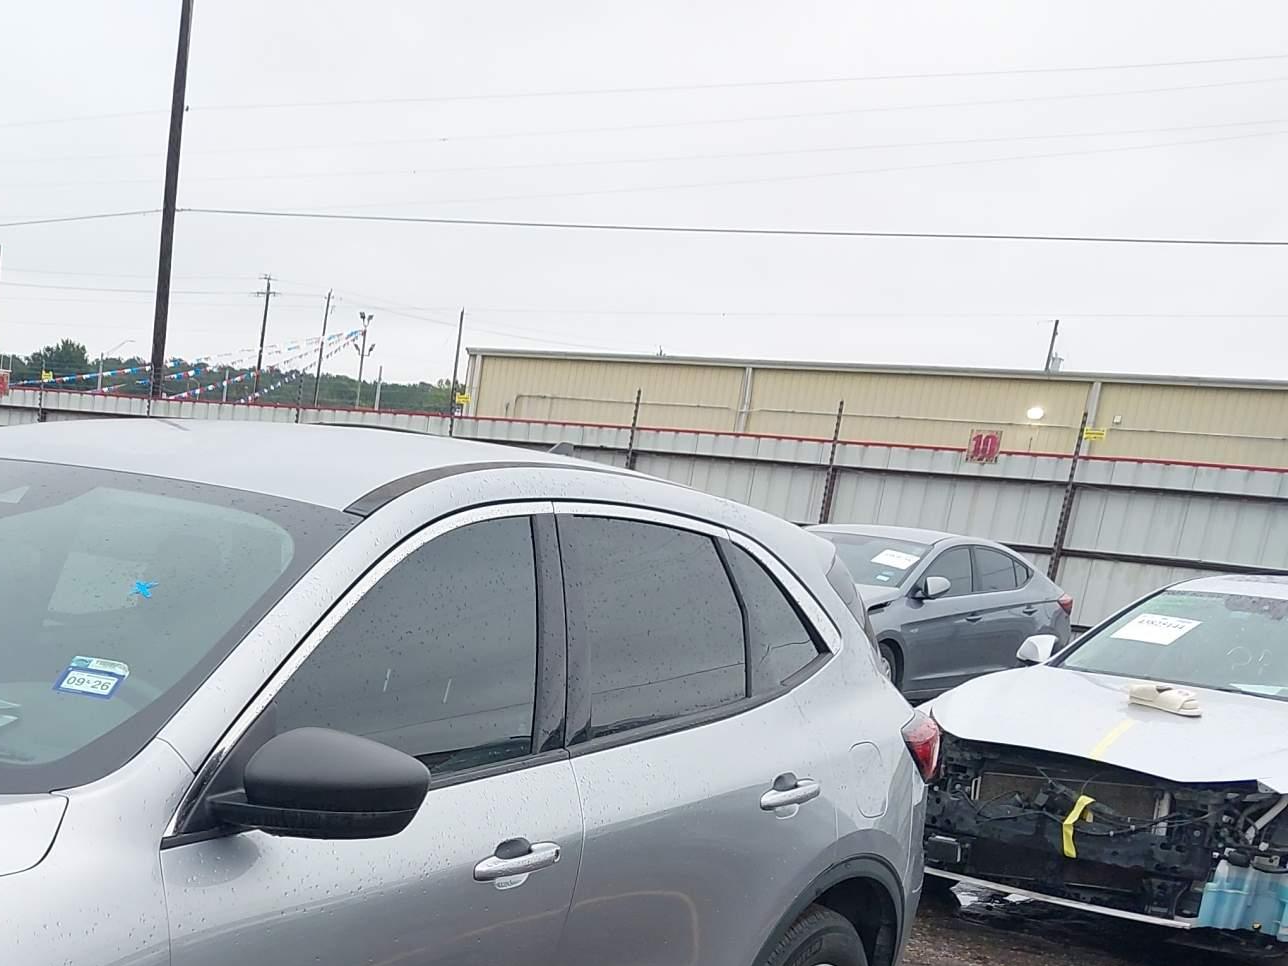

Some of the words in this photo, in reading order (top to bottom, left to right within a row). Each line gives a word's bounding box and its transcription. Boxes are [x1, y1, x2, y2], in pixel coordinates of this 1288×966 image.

[972, 433, 999, 459] 10
[66, 675, 86, 687] 09
[91, 679, 112, 691] 26
